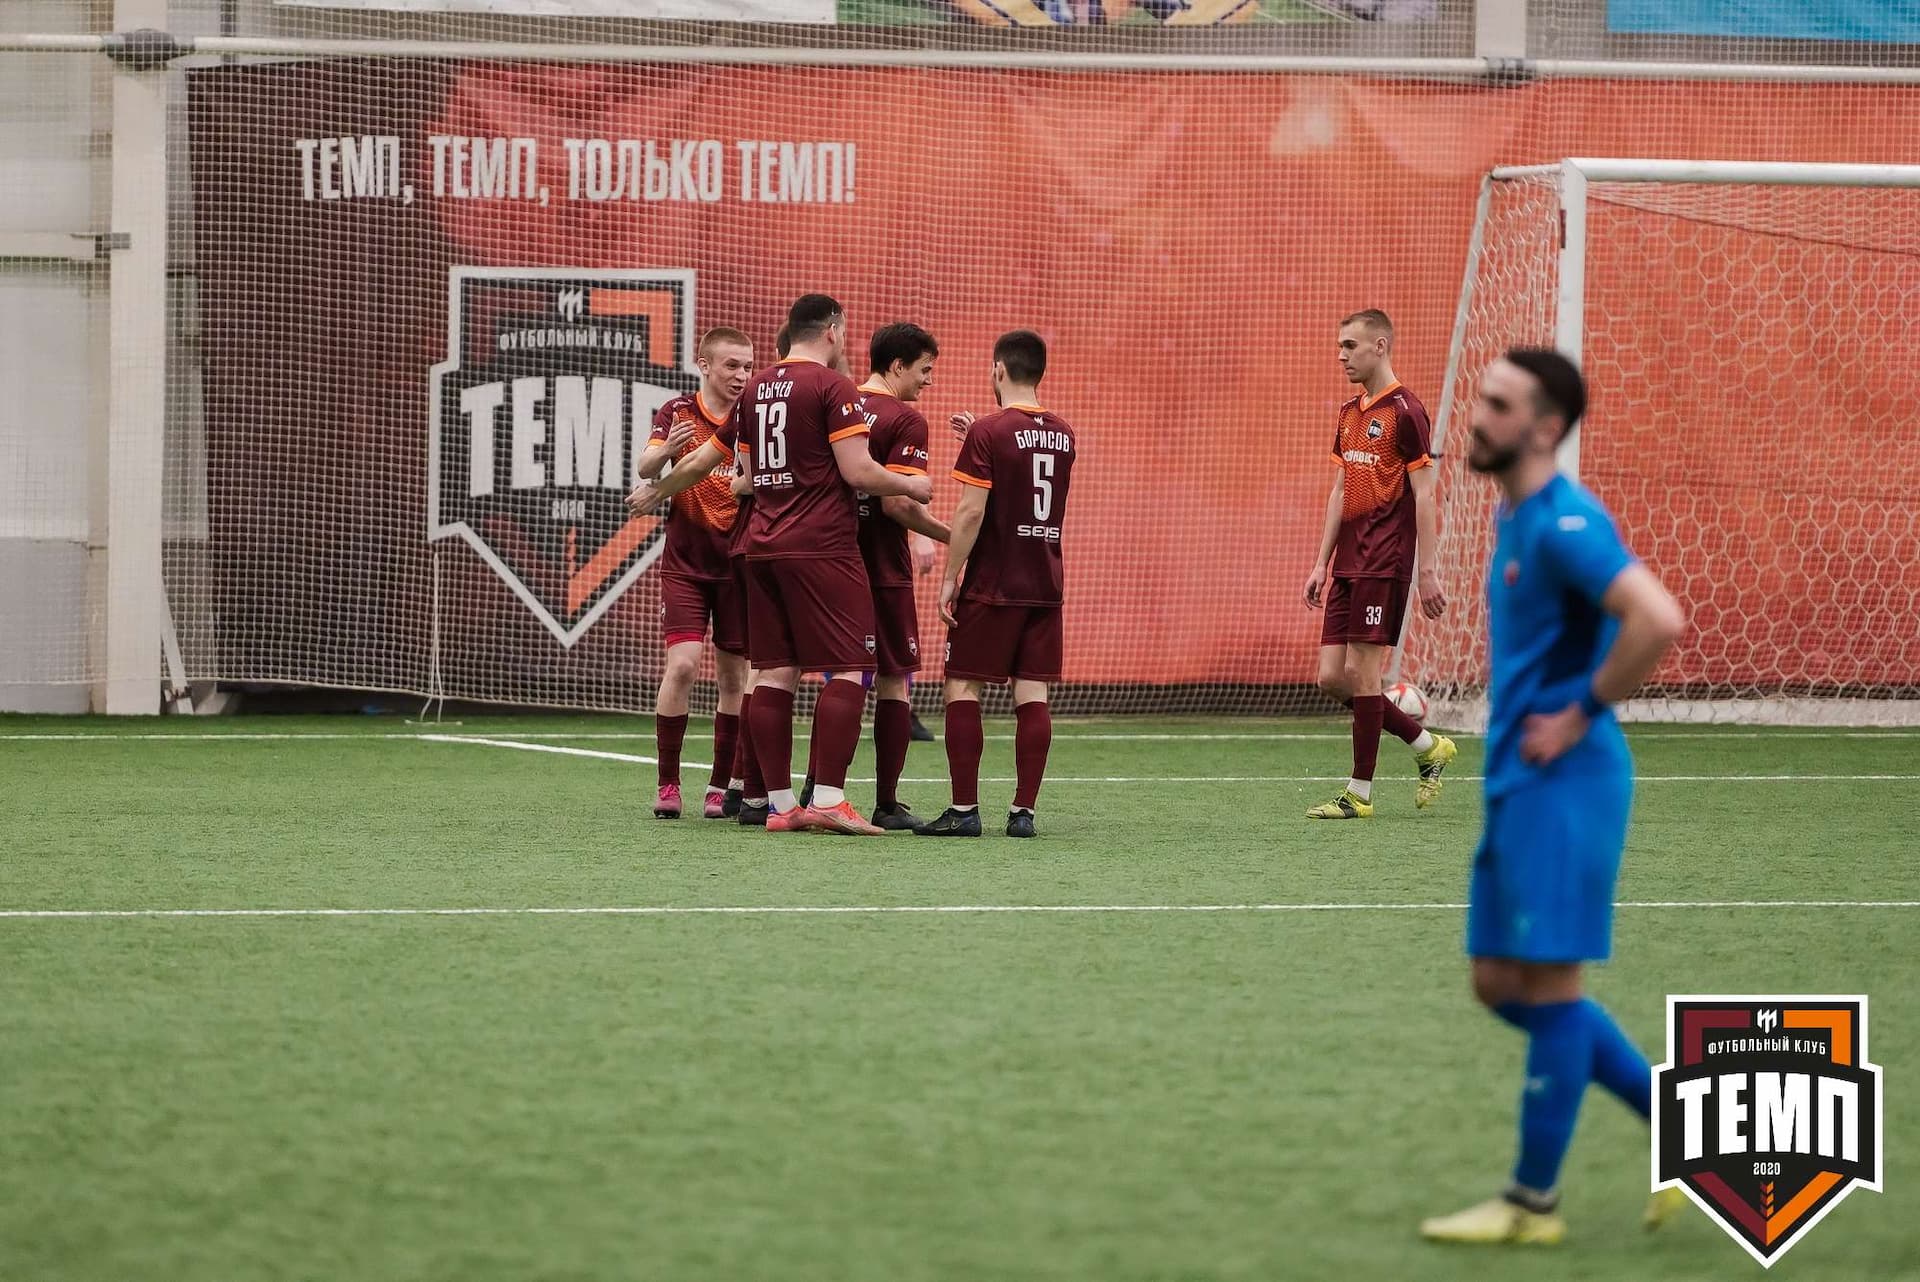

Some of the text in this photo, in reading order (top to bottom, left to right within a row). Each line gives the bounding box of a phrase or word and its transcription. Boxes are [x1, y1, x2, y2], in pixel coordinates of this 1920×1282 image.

[296, 135, 856, 207] ТЕМП, ТЕМП, ТОЛЬКО ТЕМП!
[500, 325, 642, 352] ФУТБОЛЬНЫЙ КЛУБ
[757, 381, 794, 400] СЫЧЕВ
[755, 401, 787, 469] 13
[1015, 429, 1070, 453] БОРИСОВ
[753, 472, 793, 487] SEUS
[1033, 453, 1055, 521] 5
[1365, 605, 1382, 625] 33
